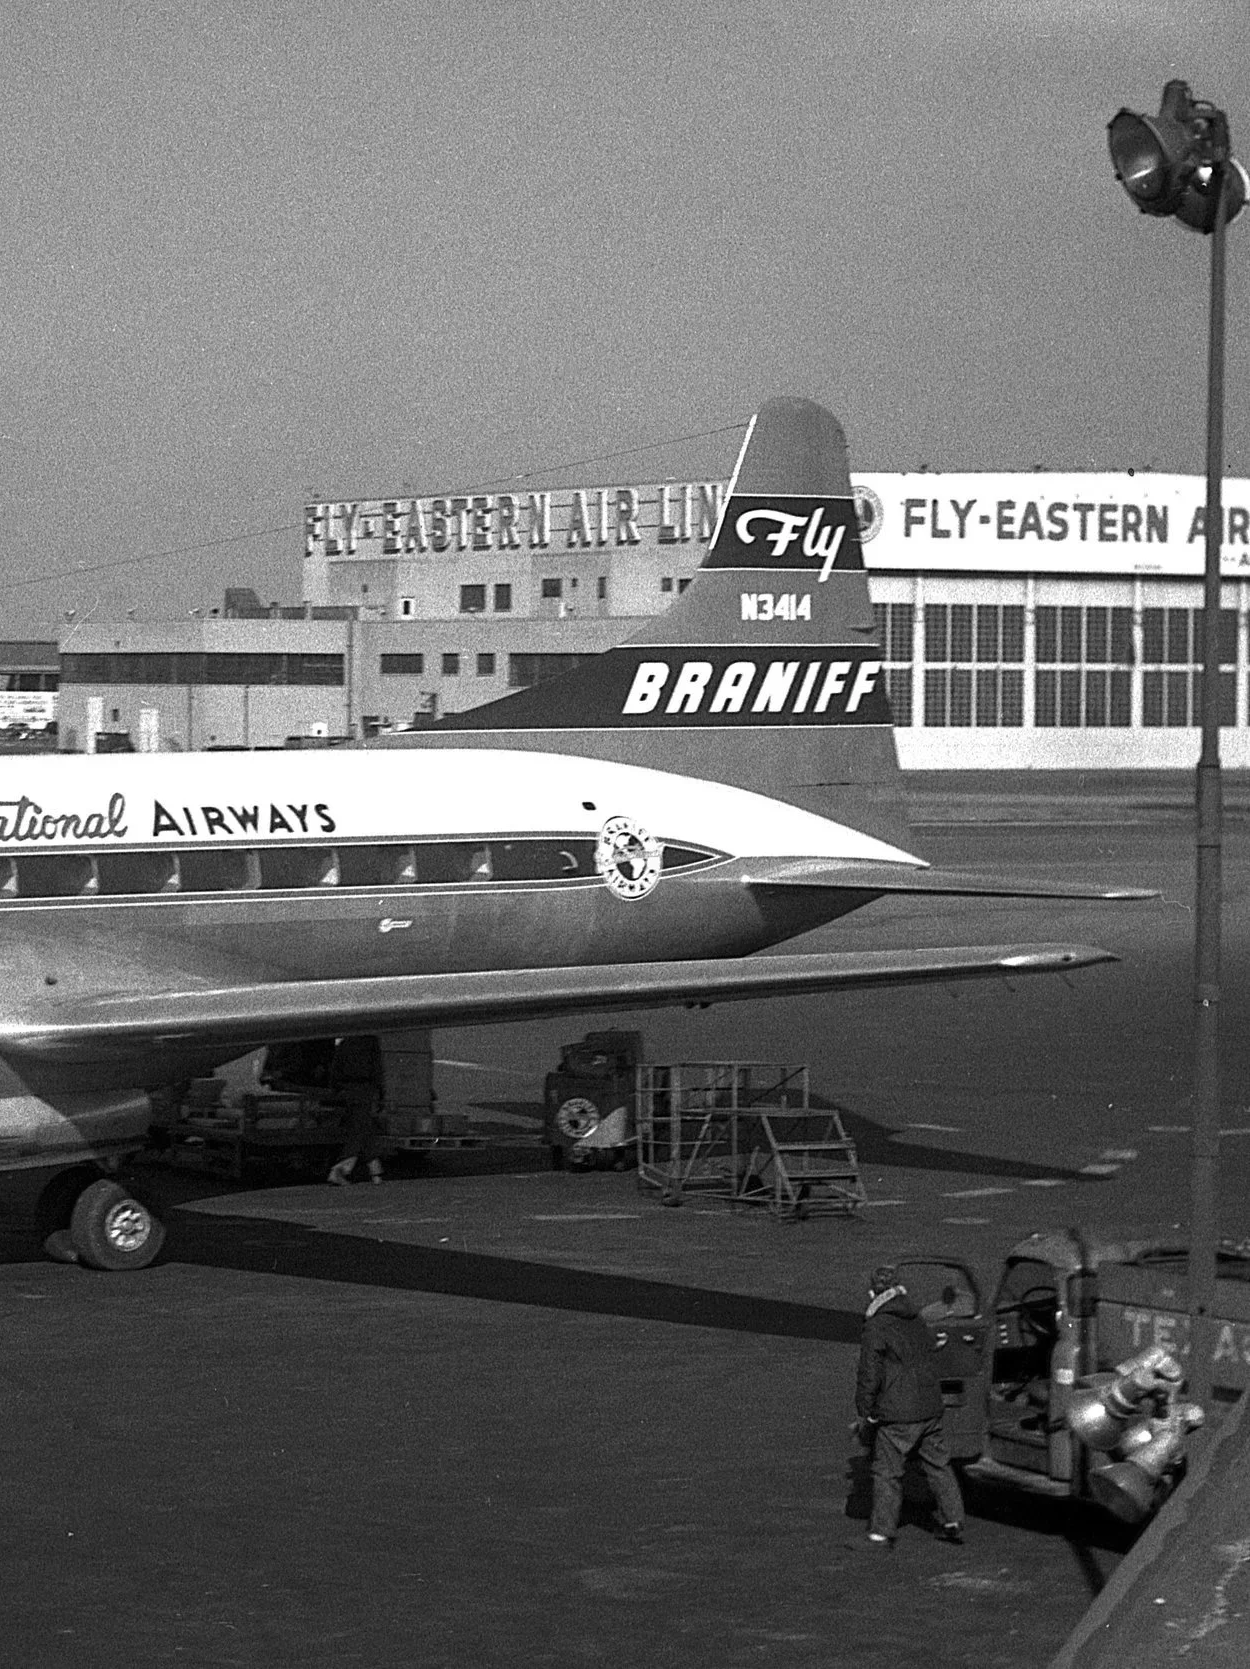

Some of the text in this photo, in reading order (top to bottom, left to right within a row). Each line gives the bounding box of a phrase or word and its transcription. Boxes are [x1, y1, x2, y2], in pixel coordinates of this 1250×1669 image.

[567, 489, 641, 549] AIR
[904, 498, 1168, 544] FLY-EASTERN
[1187, 505, 1250, 545] AR
[735, 507, 846, 583] Fly
[741, 593, 811, 621] N3414
[622, 661, 882, 714] BRANIFF
[152, 799, 336, 837] AIRWAYS
